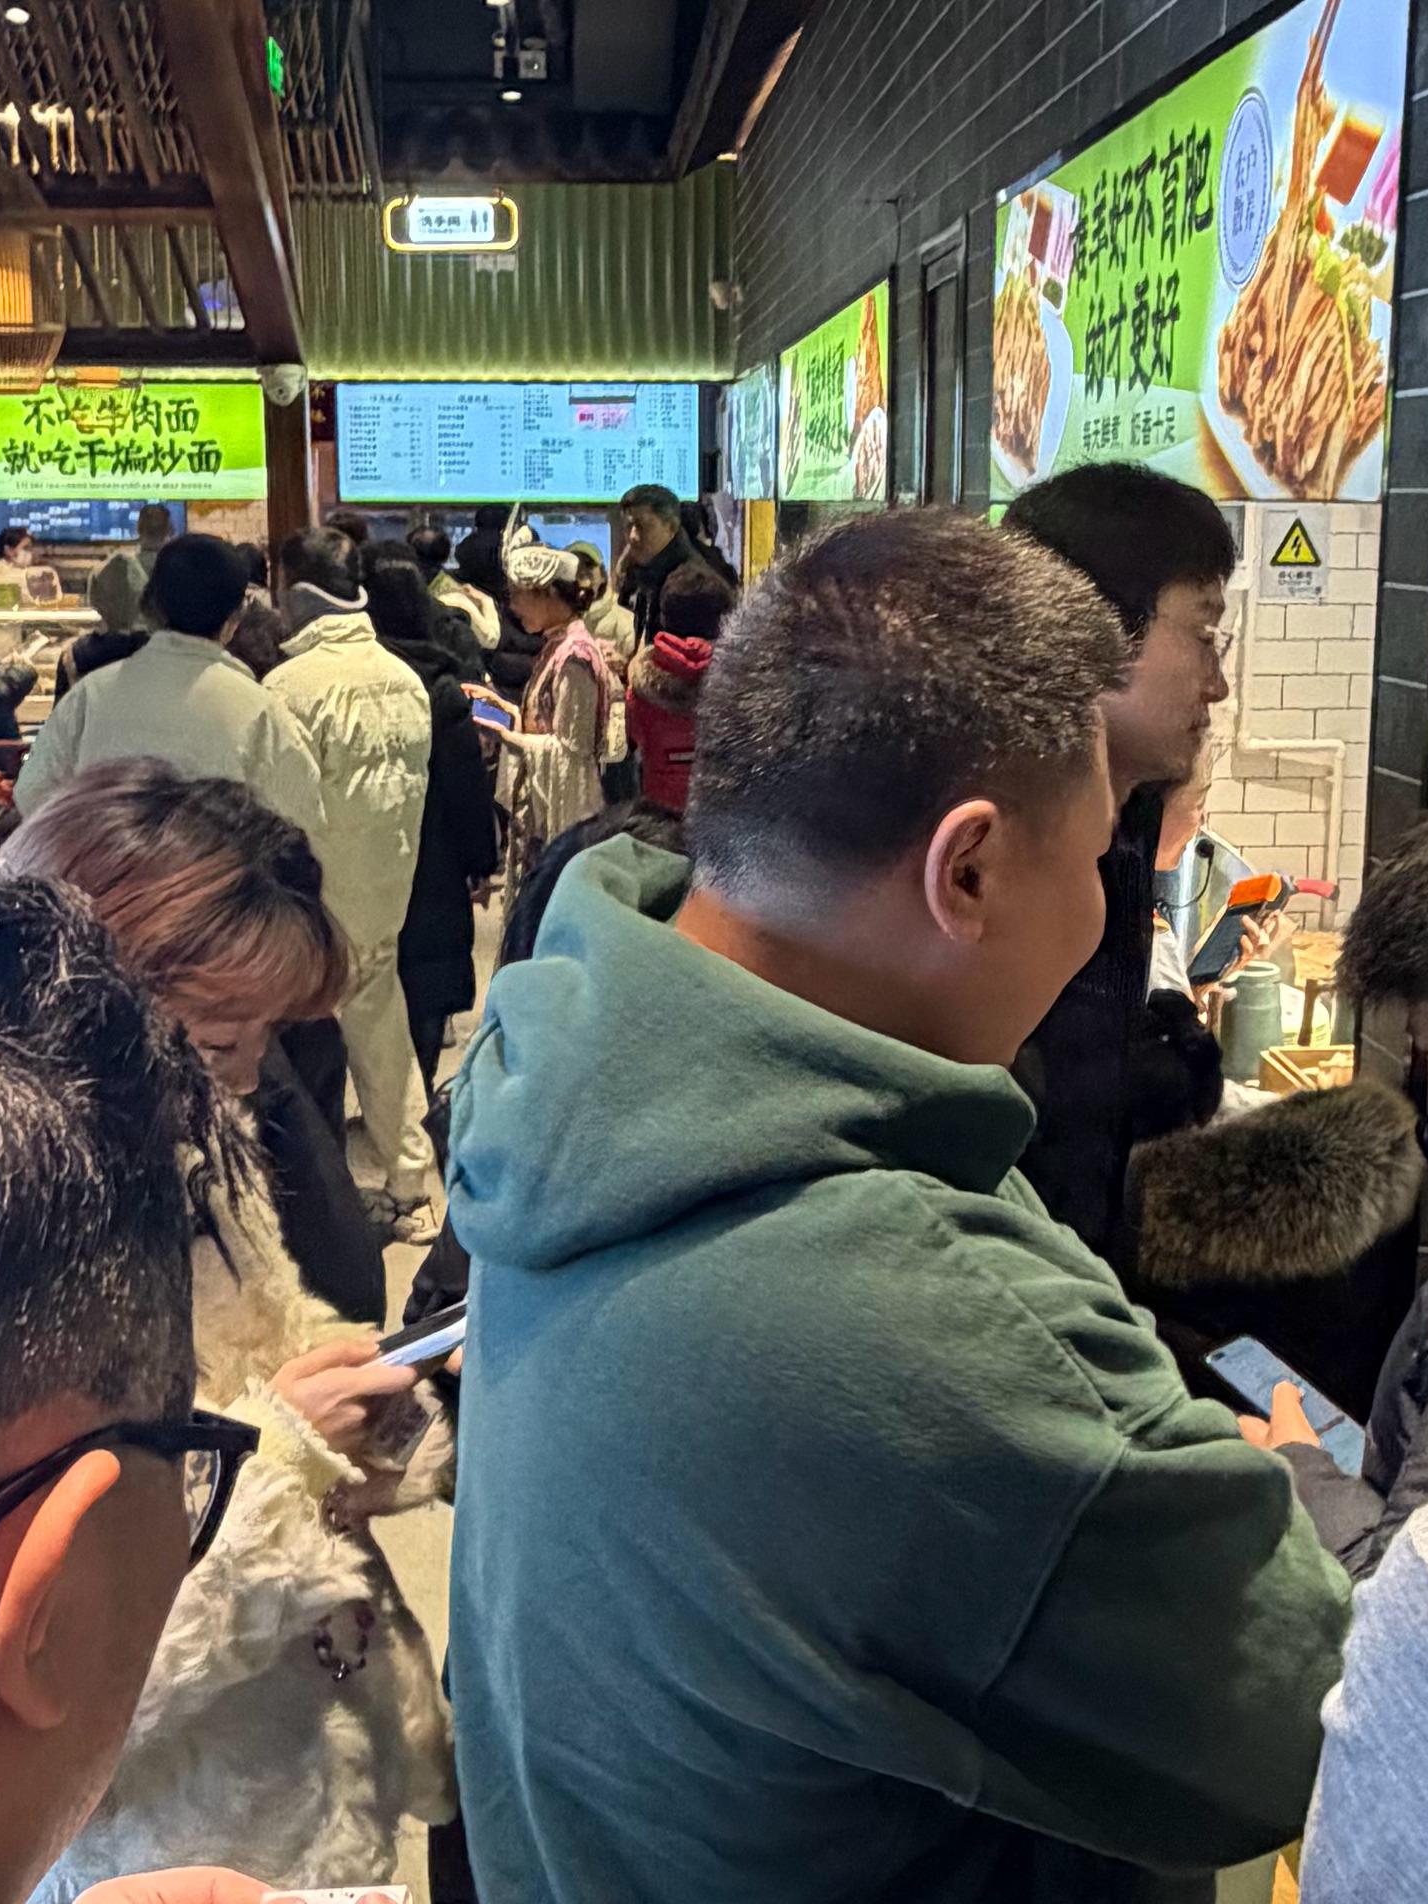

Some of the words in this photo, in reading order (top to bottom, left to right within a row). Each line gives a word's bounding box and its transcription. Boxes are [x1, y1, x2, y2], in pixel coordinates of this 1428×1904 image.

[21, 395, 201, 437] 不吃牛肉面
